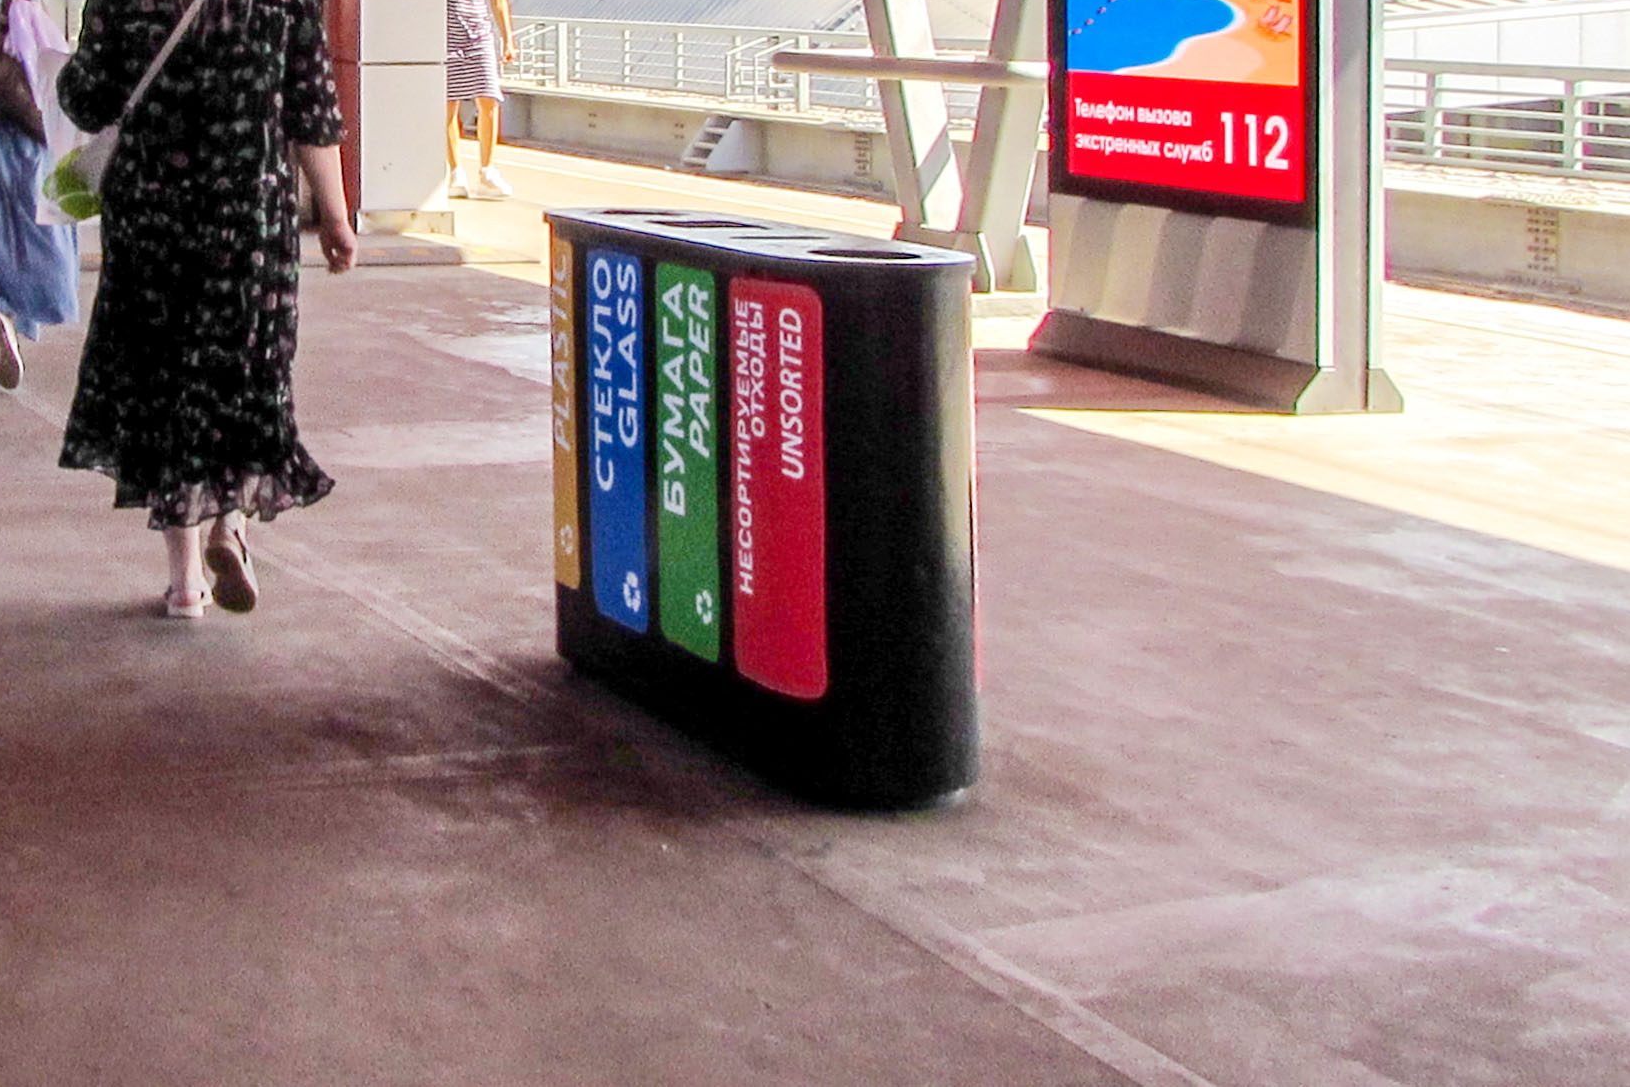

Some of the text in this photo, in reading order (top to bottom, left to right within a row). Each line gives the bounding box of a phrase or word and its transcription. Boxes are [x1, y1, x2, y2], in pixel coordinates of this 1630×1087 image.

[1074, 97, 1193, 127] Телефон вызова
[1074, 132, 1214, 164] экстренных служб
[1220, 111, 1289, 170] 112
[592, 257, 615, 493] СТЕКЛО
[616, 262, 639, 449] GLASS
[661, 281, 686, 517] БУМАГА
[687, 282, 711, 460] PAPER
[749, 301, 767, 438] ОТХОДЫ
[778, 306, 805, 480] UNSORTED
[734, 296, 755, 596] НЕСОРТИРУЕМЫЕ
